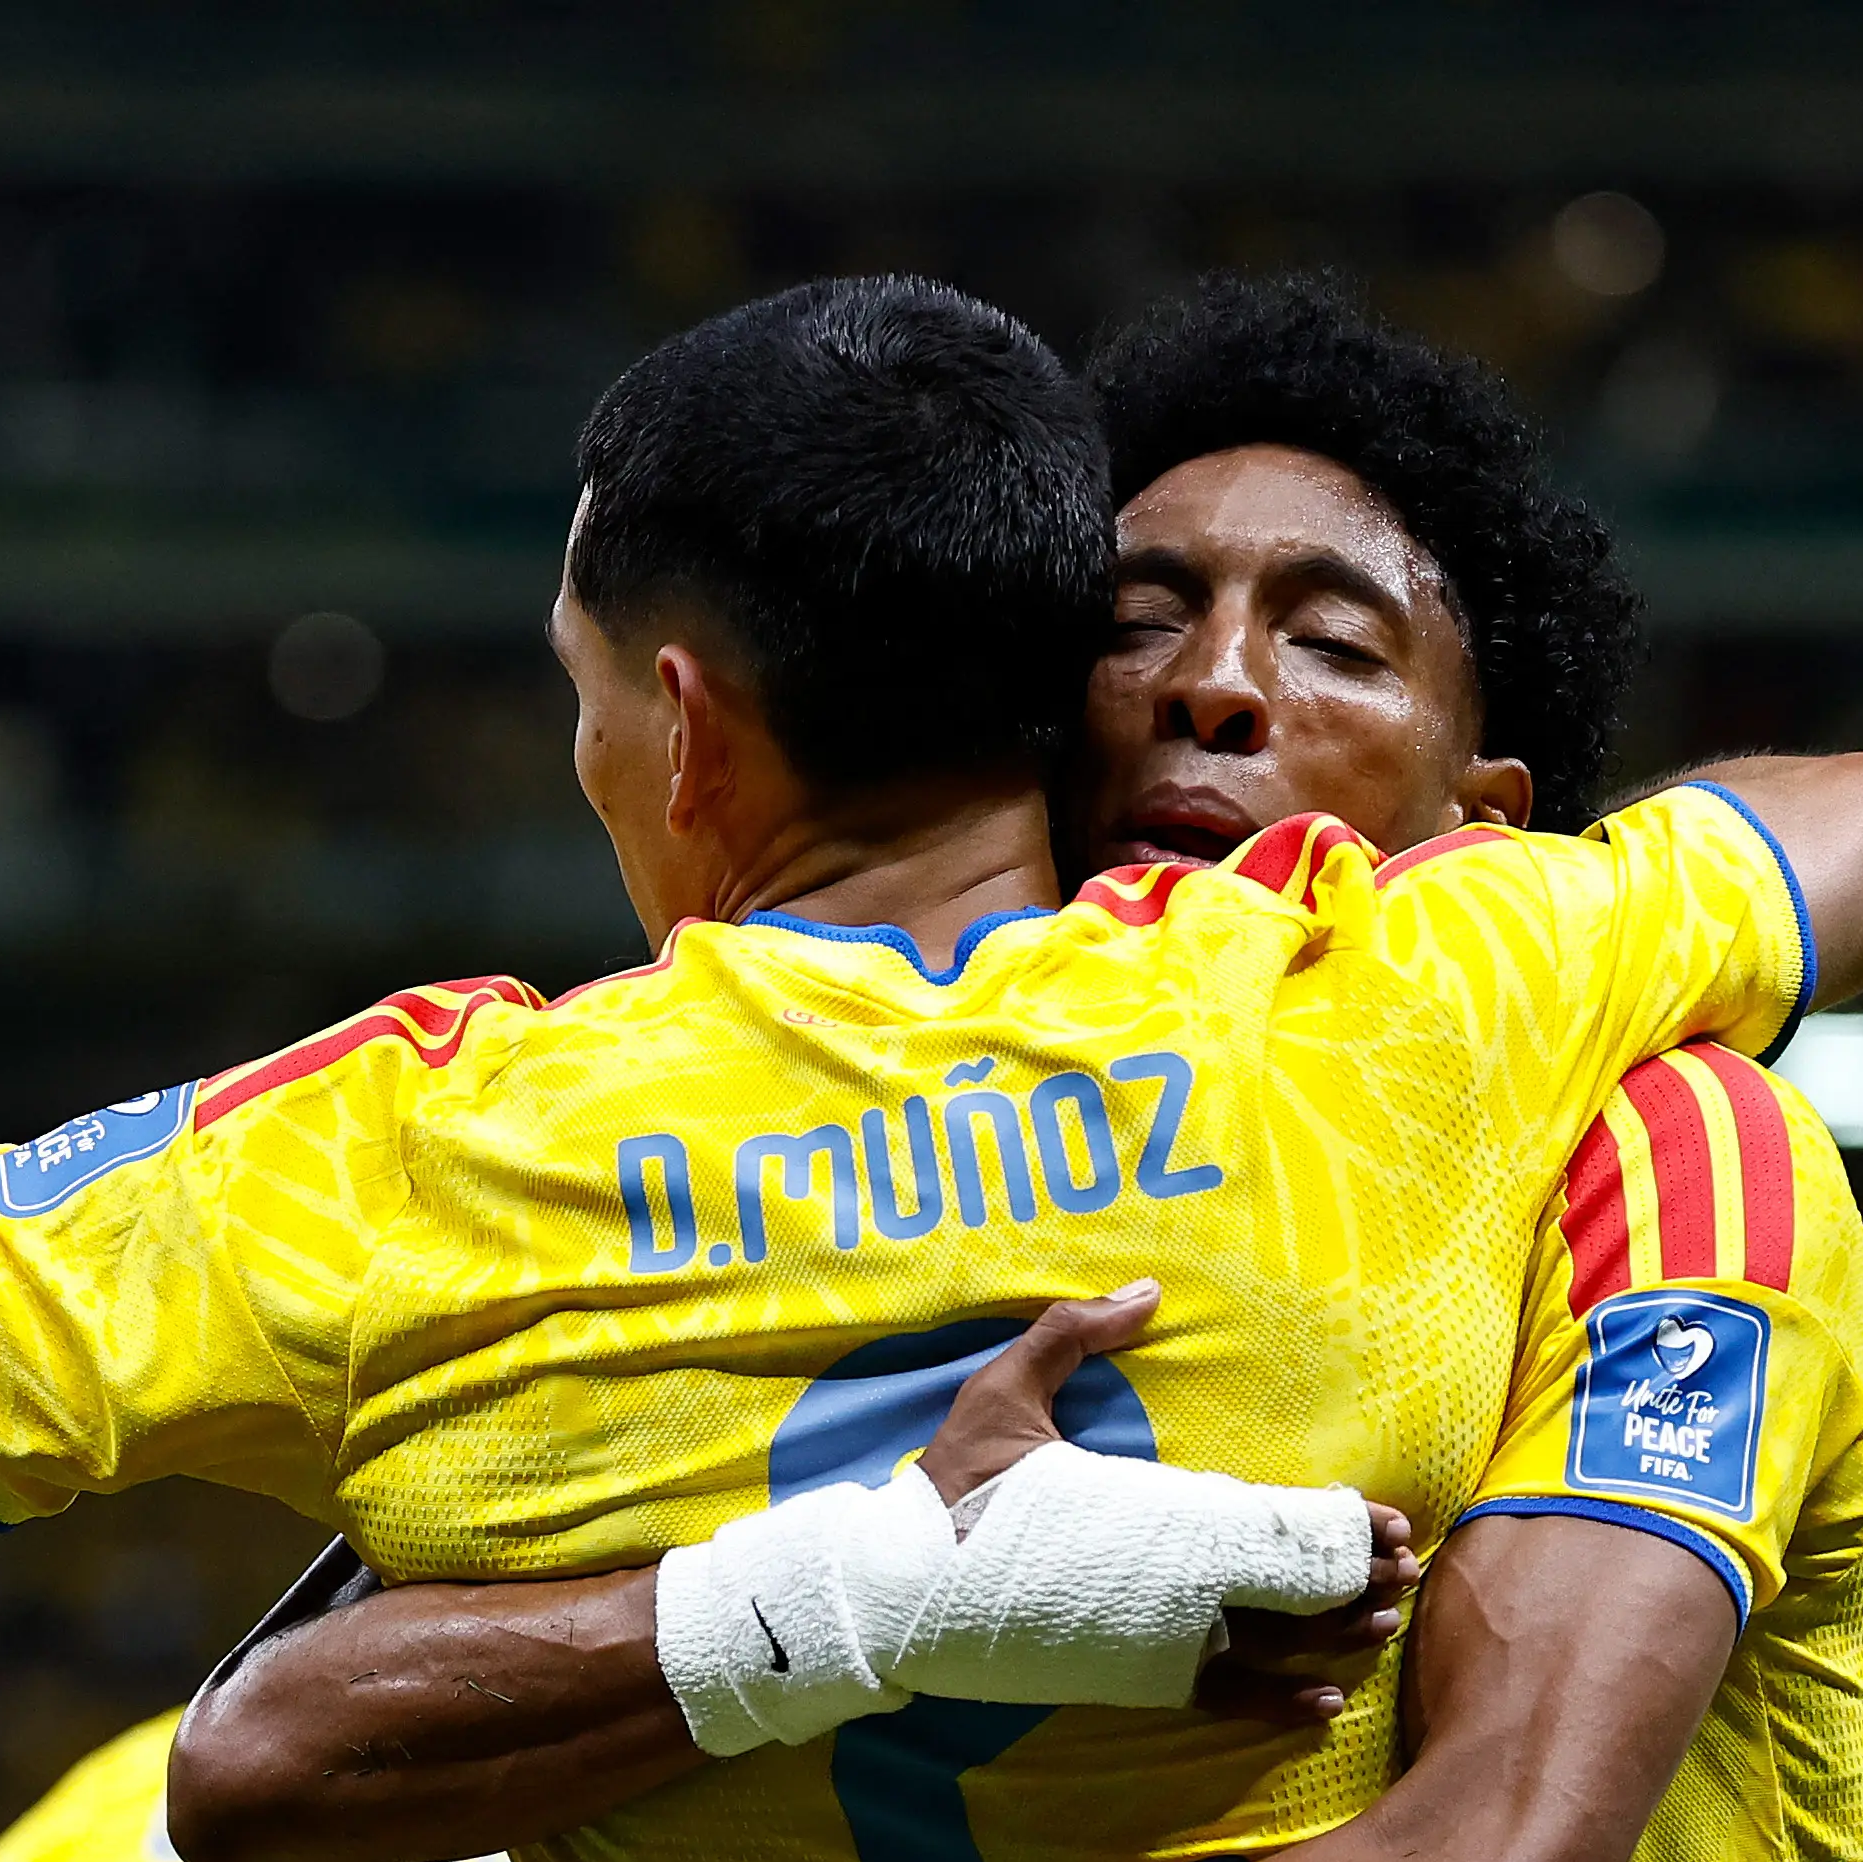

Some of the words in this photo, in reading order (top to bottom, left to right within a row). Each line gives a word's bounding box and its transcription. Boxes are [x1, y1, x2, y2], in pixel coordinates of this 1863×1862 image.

[618, 1051, 1224, 1273] D.MUÑOZ
[1621, 1378, 1683, 1416] Unite
[1685, 1391, 1720, 1425] For
[1623, 1412, 1713, 1464] PEACE
[1640, 1456, 1693, 1482] FIFA
